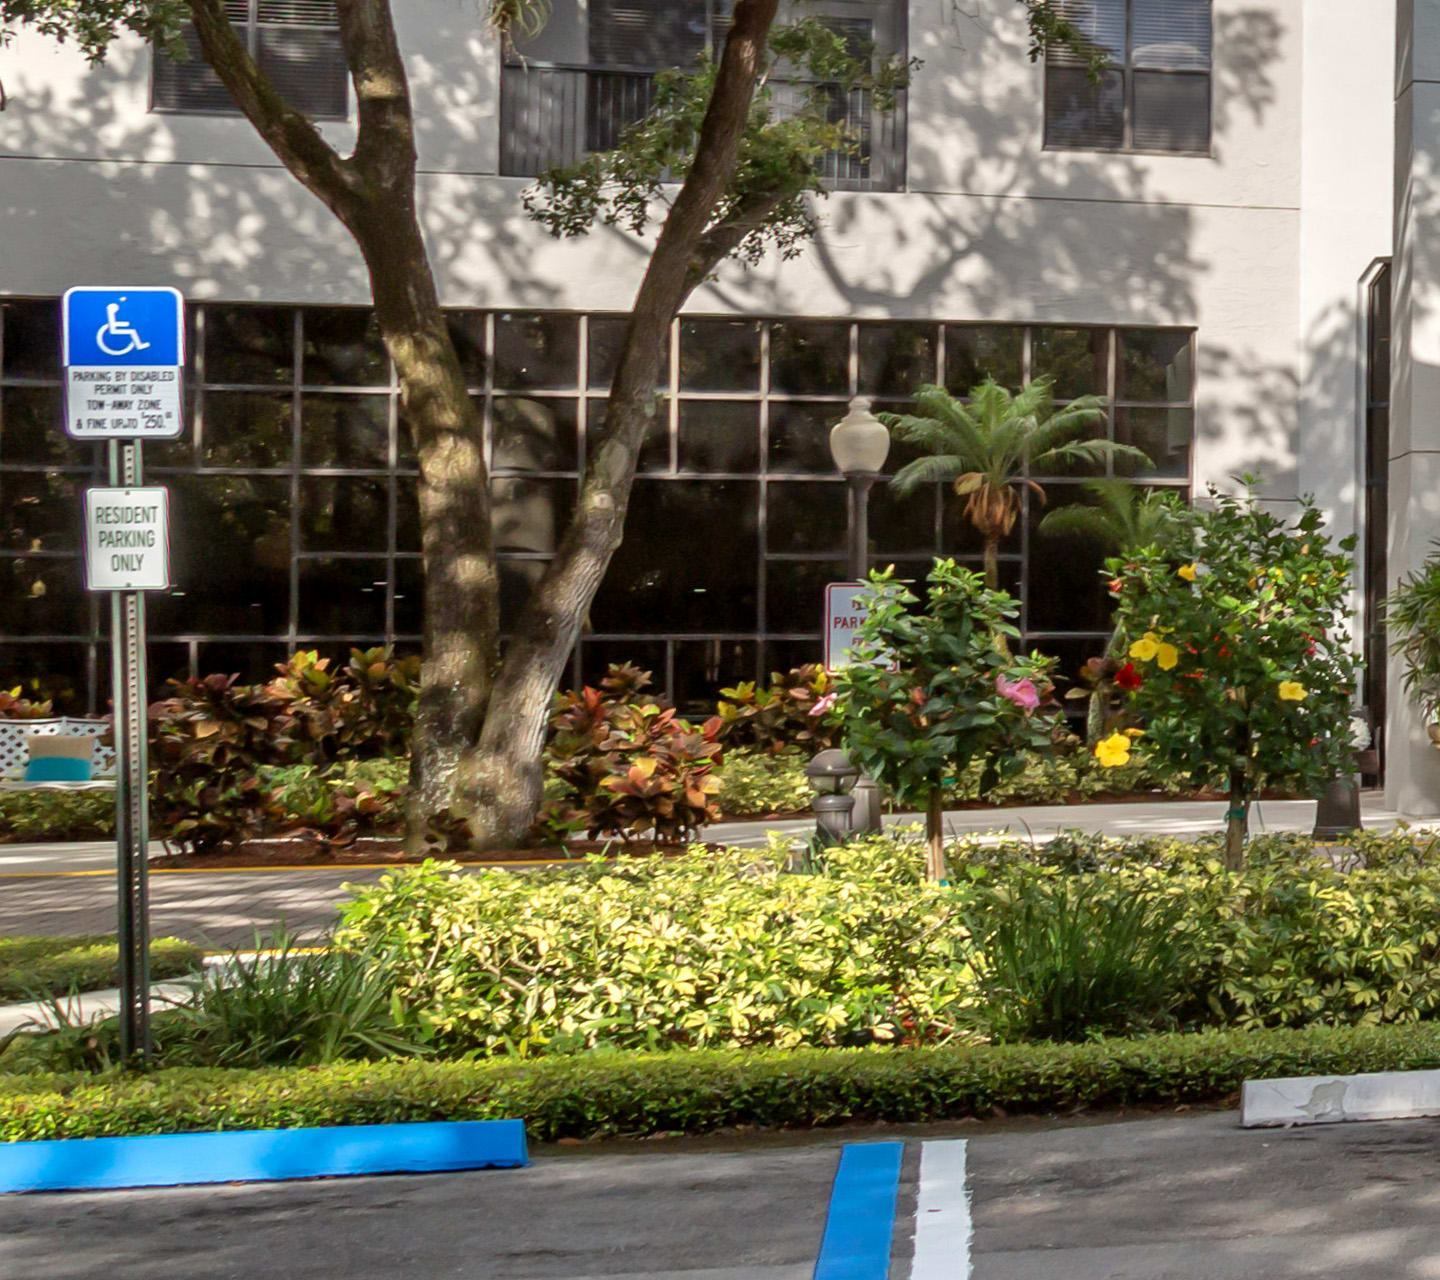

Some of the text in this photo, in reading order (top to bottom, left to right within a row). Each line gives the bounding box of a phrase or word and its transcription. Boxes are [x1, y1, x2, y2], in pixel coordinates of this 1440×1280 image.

[73, 370, 175, 382] PARKING BY DISABLED
[94, 384, 153, 395] PERMIT ONLY
[87, 399, 162, 410] TOW-AWAY ZONE
[87, 418, 107, 430] FINE
[95, 505, 158, 525] RESIDENT
[98, 530, 156, 548] PARKING
[111, 553, 144, 572] ONLY
